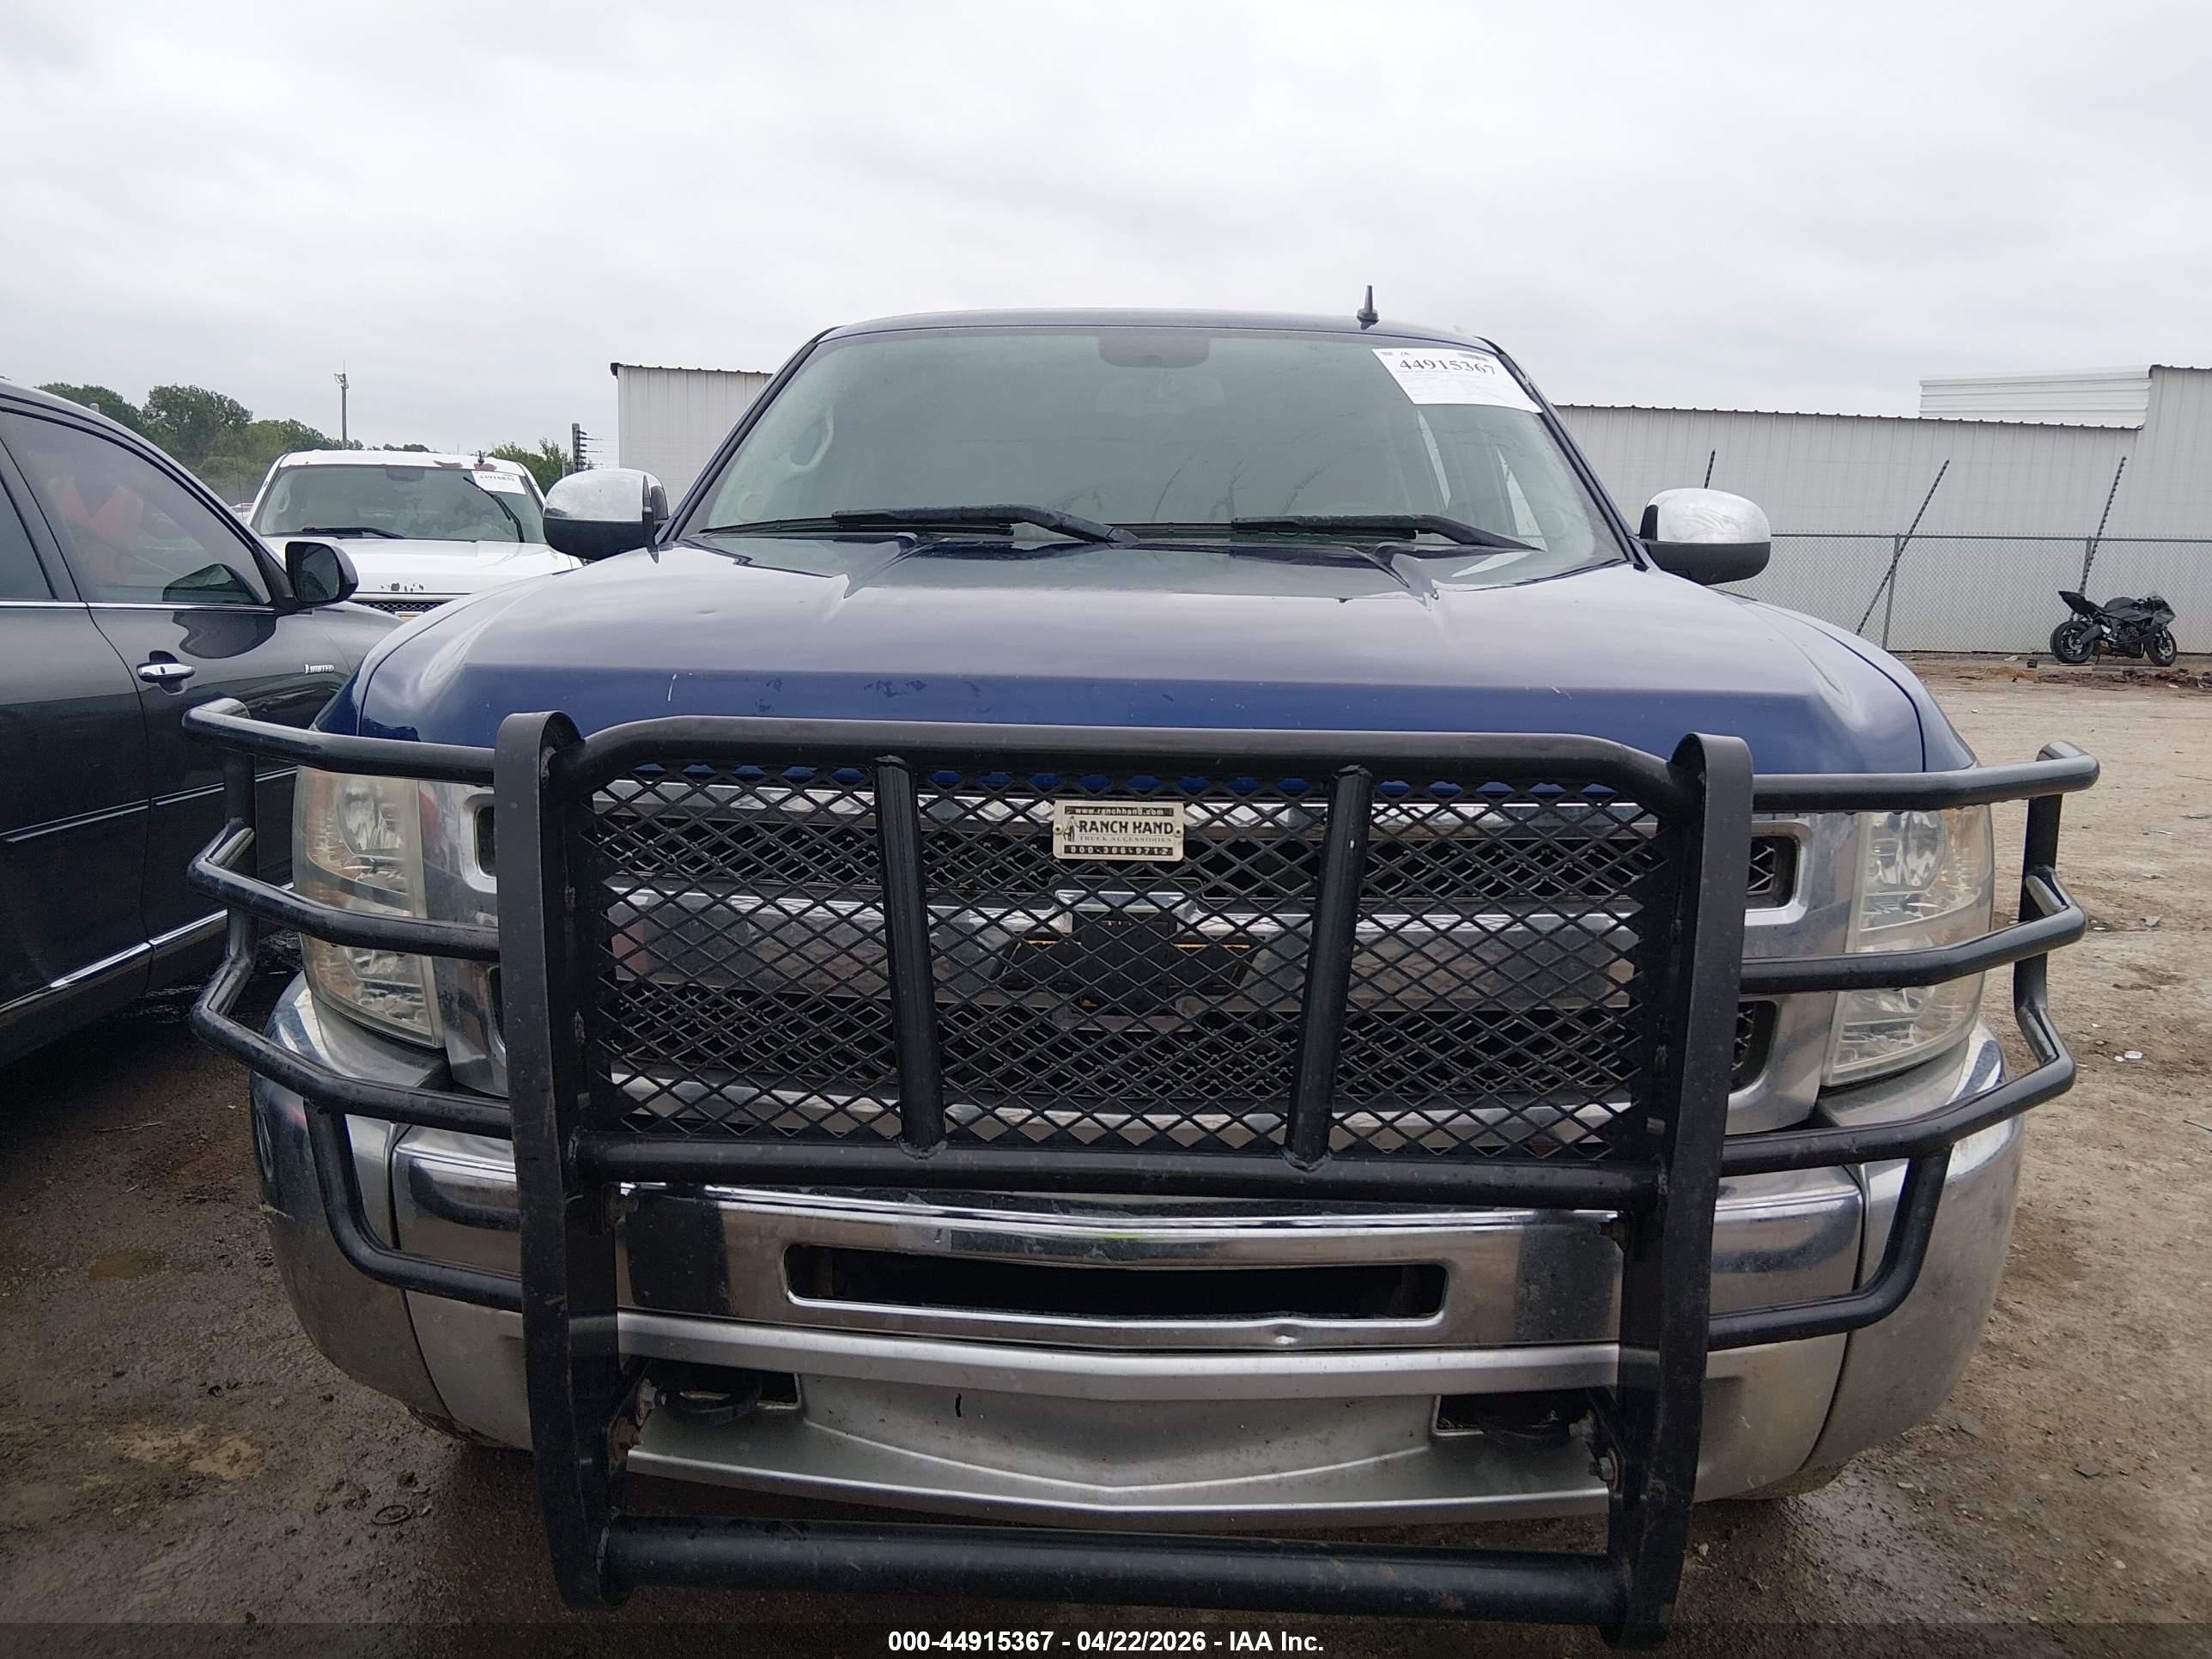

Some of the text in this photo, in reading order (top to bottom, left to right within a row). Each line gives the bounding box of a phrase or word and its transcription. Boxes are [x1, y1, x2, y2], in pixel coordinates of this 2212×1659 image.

[1400, 359, 1496, 375] 44915367
[1074, 807, 1164, 817] www.ranchhand.com
[1079, 820, 1174, 835] RANCH HAND
